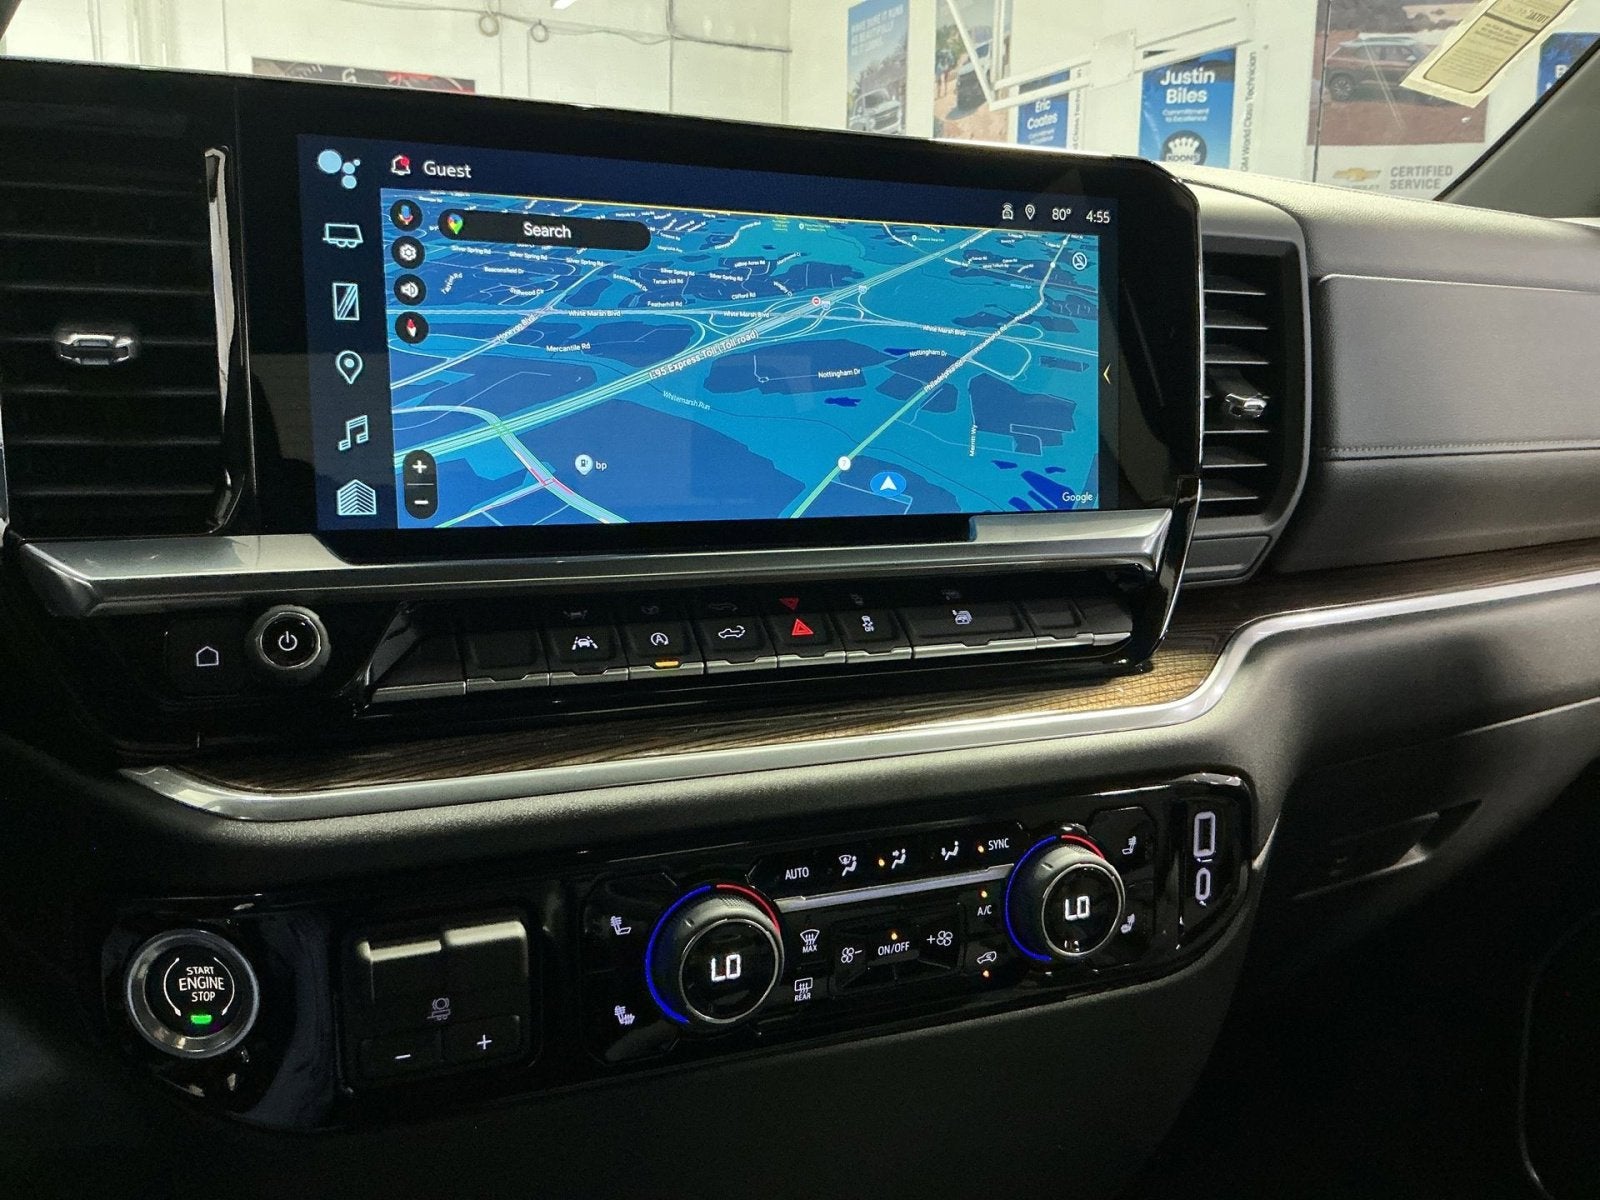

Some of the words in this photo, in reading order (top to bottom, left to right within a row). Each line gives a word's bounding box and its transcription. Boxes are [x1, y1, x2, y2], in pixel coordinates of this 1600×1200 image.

[1160, 66, 1215, 86] Justin
[1244, 51, 1257, 102] Technician
[1165, 87, 1208, 104] Biles
[1035, 99, 1051, 113] Eric
[1243, 103, 1254, 128] Class
[1241, 129, 1252, 155] World
[423, 160, 472, 180] Guest
[1390, 165, 1453, 177] CERTIFIED
[1389, 179, 1441, 190] SERVICE
[1086, 210, 1110, 223] 4:55
[523, 221, 572, 238] Search
[467, 246, 483, 255] Spring
[524, 252, 540, 261] Spring
[580, 259, 596, 267] Spring
[484, 266, 517, 274] Beaconsfield
[674, 269, 689, 277] Spring
[722, 274, 737, 282] Spring
[922, 325, 937, 333] White
[546, 344, 580, 352] Mercantile
[581, 342, 591, 350] Rd
[668, 355, 701, 373] Express
[702, 345, 717, 358] Toll
[718, 340, 736, 354] (Toll
[737, 329, 759, 343] road)
[909, 348, 940, 357] Nottingham
[941, 349, 948, 357] Dr
[818, 369, 852, 379] Nottingham
[595, 459, 608, 472] bp
[1062, 491, 1093, 504] Google
[988, 838, 1010, 851] SYNC
[785, 867, 810, 881] AUTO
[977, 905, 992, 917] A/C
[1064, 895, 1091, 921] LO
[802, 944, 818, 953] MAX
[877, 942, 911, 956] ON/OFF
[186, 966, 214, 976] START
[711, 953, 741, 983] LO
[179, 976, 225, 991] ENGINE
[191, 991, 216, 1002] STOP
[794, 992, 812, 1002] REAR
